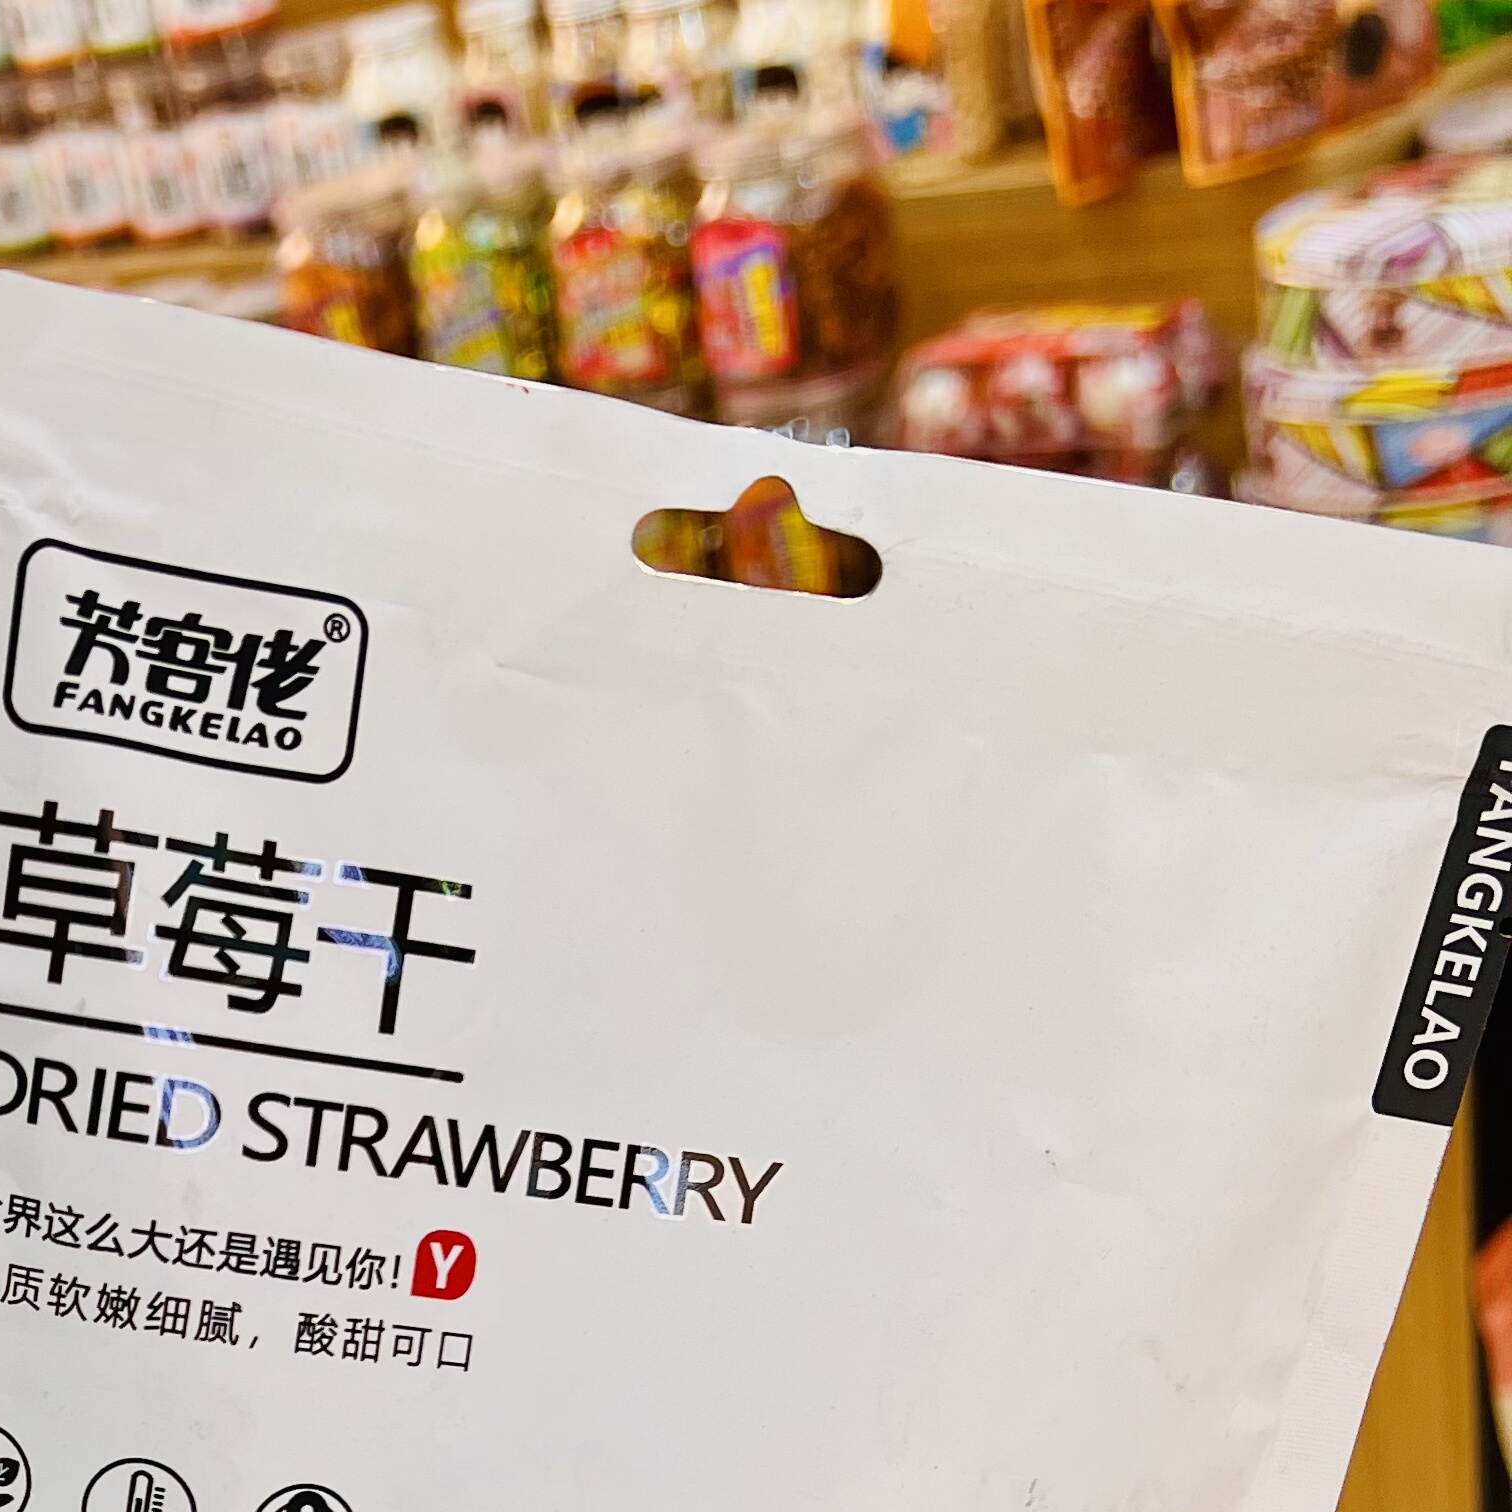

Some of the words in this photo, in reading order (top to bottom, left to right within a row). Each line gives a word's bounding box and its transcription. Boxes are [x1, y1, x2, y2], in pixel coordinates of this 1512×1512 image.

[53, 682, 303, 752] FANGKELAO
[60, 590, 326, 724] 芳客佬
[1403, 758, 1512, 1090] ANGKELAO
[241, 1092, 784, 1226] STRAWBERRY
